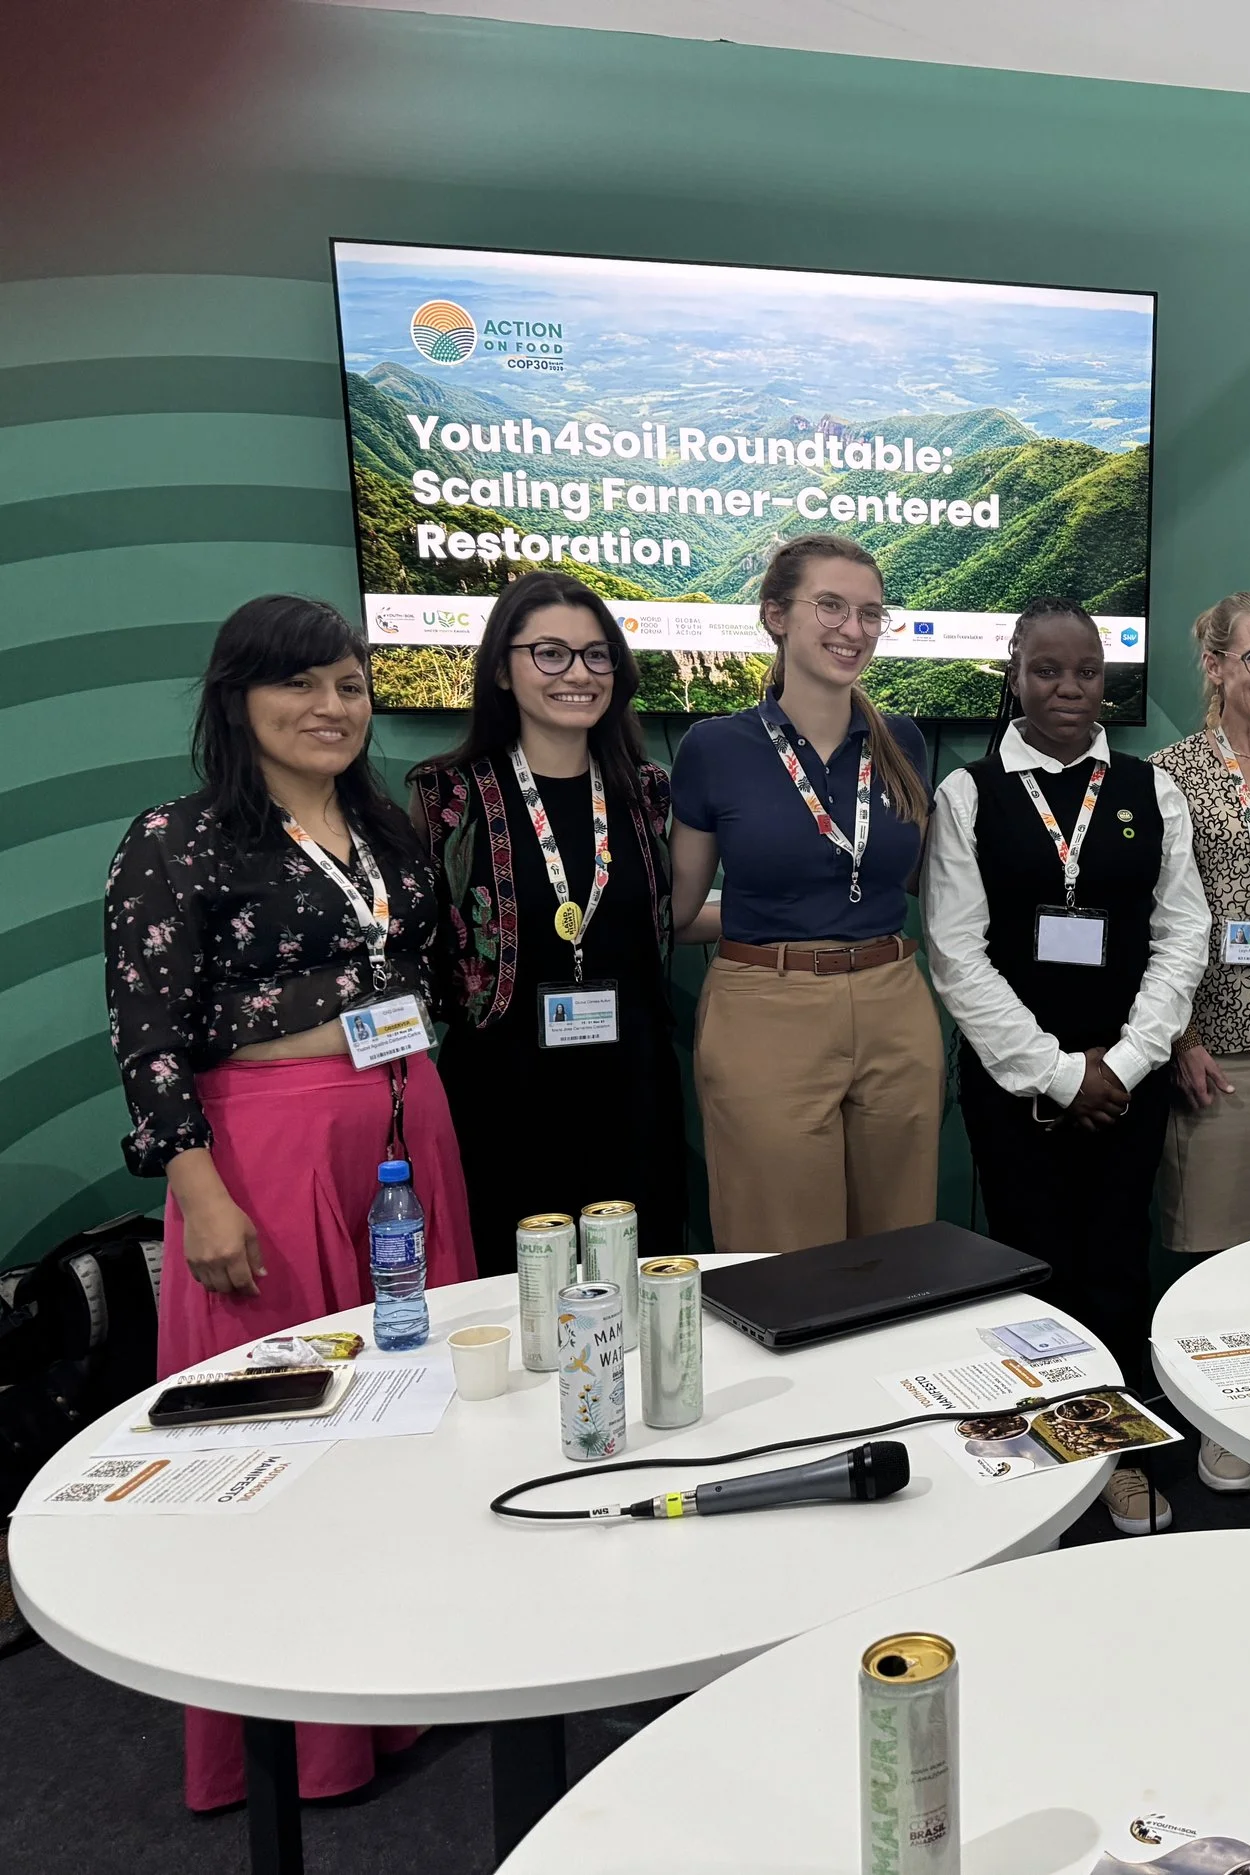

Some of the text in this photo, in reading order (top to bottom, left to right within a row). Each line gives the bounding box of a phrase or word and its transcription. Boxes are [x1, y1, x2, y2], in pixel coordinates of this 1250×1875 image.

[483, 319, 562, 338] ACTION
[484, 340, 563, 354] ON FOOD
[507, 359, 548, 370] COP30
[407, 414, 953, 475] Youth4Soil Roundtable:
[412, 469, 1000, 528] Scaling Farmer-Centered
[416, 523, 691, 567] Restoration
[217, 1456, 282, 1503] MANIFESTO
[909, 1822, 946, 1841] BRASIL
